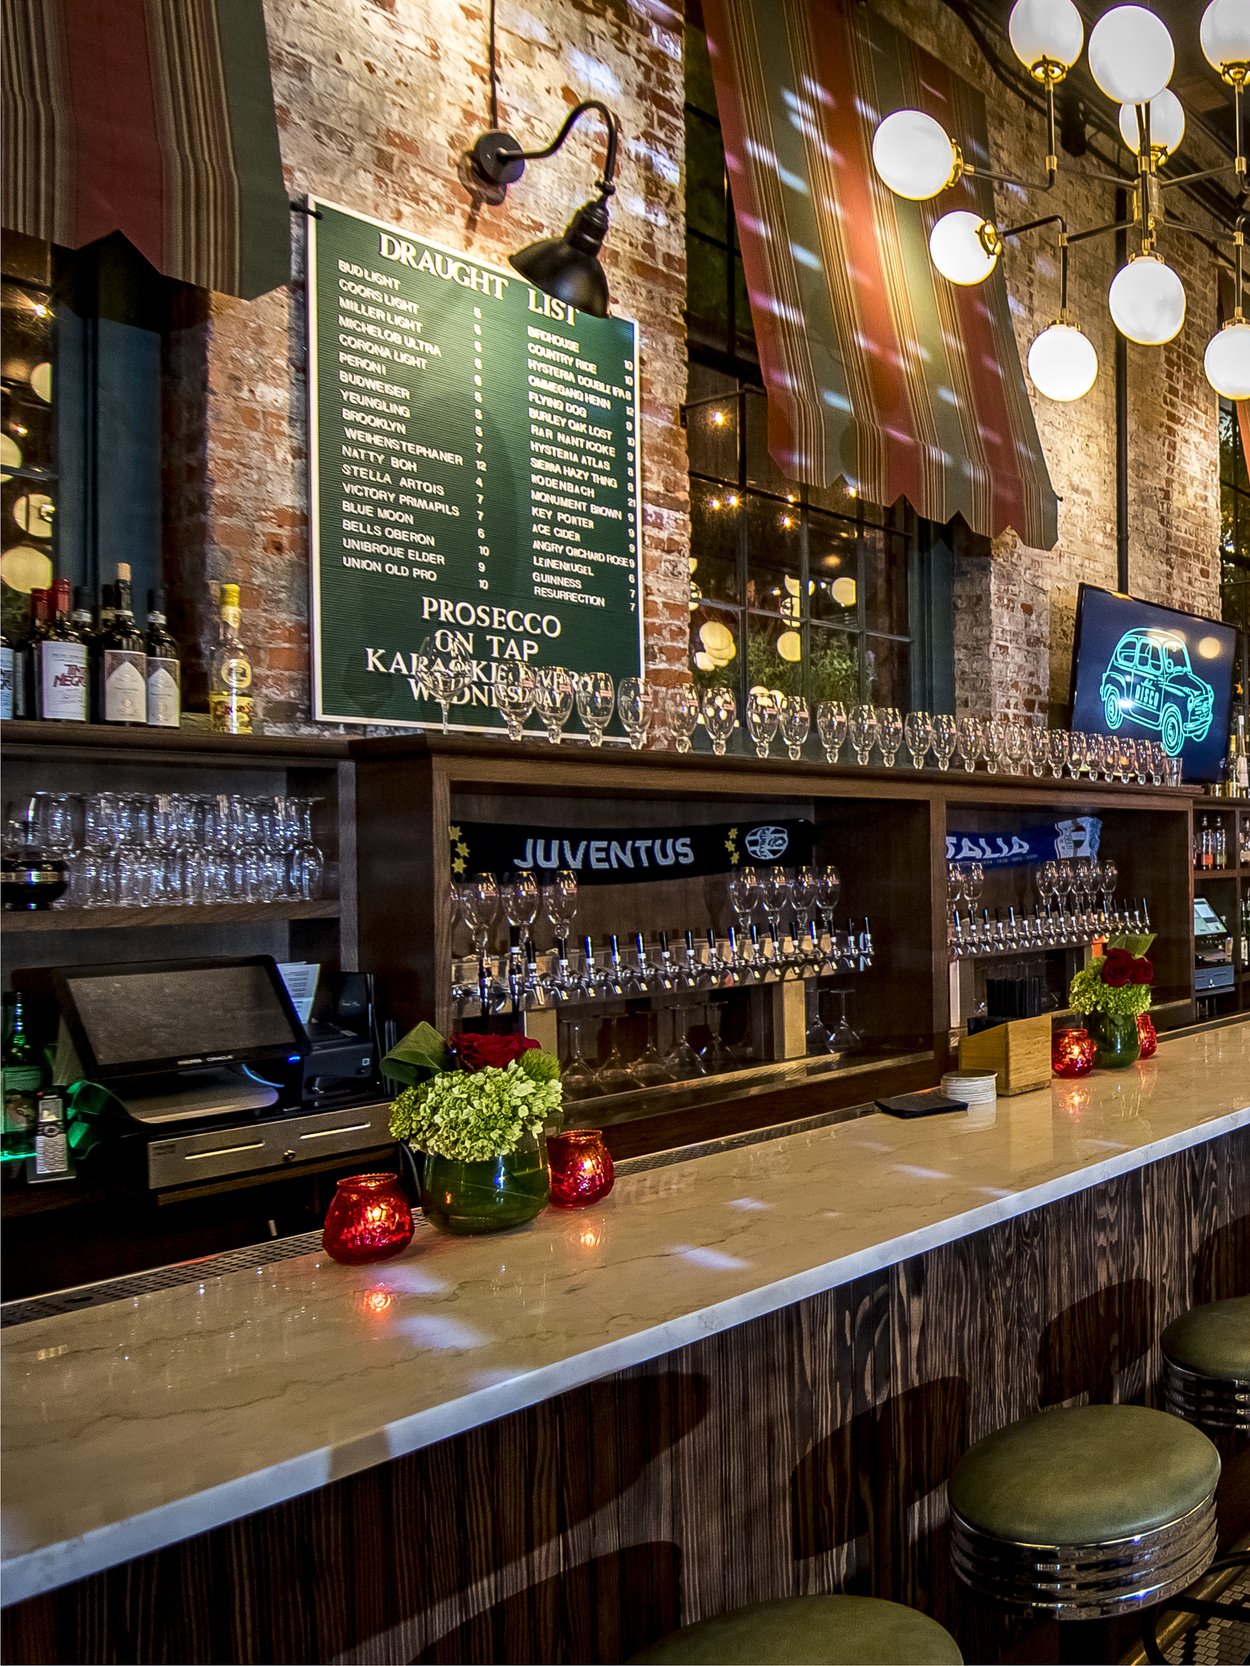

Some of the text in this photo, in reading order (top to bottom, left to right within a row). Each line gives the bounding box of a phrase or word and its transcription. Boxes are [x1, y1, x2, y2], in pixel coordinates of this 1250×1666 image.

[338, 259, 363, 278] BUD
[363, 268, 401, 291] LIGHT
[379, 231, 580, 327] DRAUGHT LIST
[338, 279, 383, 303] COORS
[384, 293, 420, 315] LIGHT
[338, 296, 386, 322] MILLER
[386, 311, 423, 333] LIGHT
[338, 314, 402, 345] MICHELOB
[403, 335, 442, 358] ULTRA
[338, 333, 393, 360] CORONA
[394, 351, 428, 370] LIGHT
[339, 351, 386, 376] PERONI
[528, 342, 575, 367] COUNTRY
[575, 357, 597, 375] RIDE
[339, 370, 410, 400] BUDWEISER
[528, 358, 576, 384] HYSTERIA
[577, 374, 612, 395] DOUBLE
[611, 385, 625, 399] IPA
[339, 389, 411, 418] YEUNGLING
[528, 390, 633, 431] FLYING DOG 9
[584, 392, 611, 410] HENN
[625, 406, 634, 417] 12
[342, 408, 483, 454] BROOKLYN 7
[528, 407, 635, 447] BURLEY OAK LOST 10
[344, 427, 487, 472] WEIHENSTEPHANER 12
[530, 441, 634, 477] HYSTERIA ATLAS 8
[557, 432, 616, 458] NANTICOKE
[626, 452, 634, 462] 9
[342, 445, 484, 488] NATTY BOH 4
[530, 457, 634, 492] SIERRA HAZY THING 8
[342, 464, 484, 505] STELLA ARTOIS 7
[342, 482, 484, 522] VICTORY PRIMAPILS 7
[530, 490, 634, 523] MONUMENT BROWN 9
[342, 500, 485, 539] BLUE MOON 6
[531, 506, 635, 538] KEY PORTER 9
[342, 519, 490, 557] BELLS OBERON 10
[532, 524, 635, 554] ACE CIDER 9
[532, 540, 635, 569] ANGRY ORCHARD ROSE 9
[342, 538, 486, 573] UNIBROUE ELDER 9
[342, 556, 489, 590] UNION OLD PRO 10
[532, 572, 636, 599] GUINNESS 7
[628, 574, 635, 584] 6
[533, 586, 636, 612] RESURRECTION 7
[421, 596, 562, 638] PROSECCO
[434, 629, 539, 662] ON TAP
[1135, 685, 1159, 707] DISCO
[513, 837, 695, 869] JUVENTUS
[946, 836, 1030, 859] TALIA
